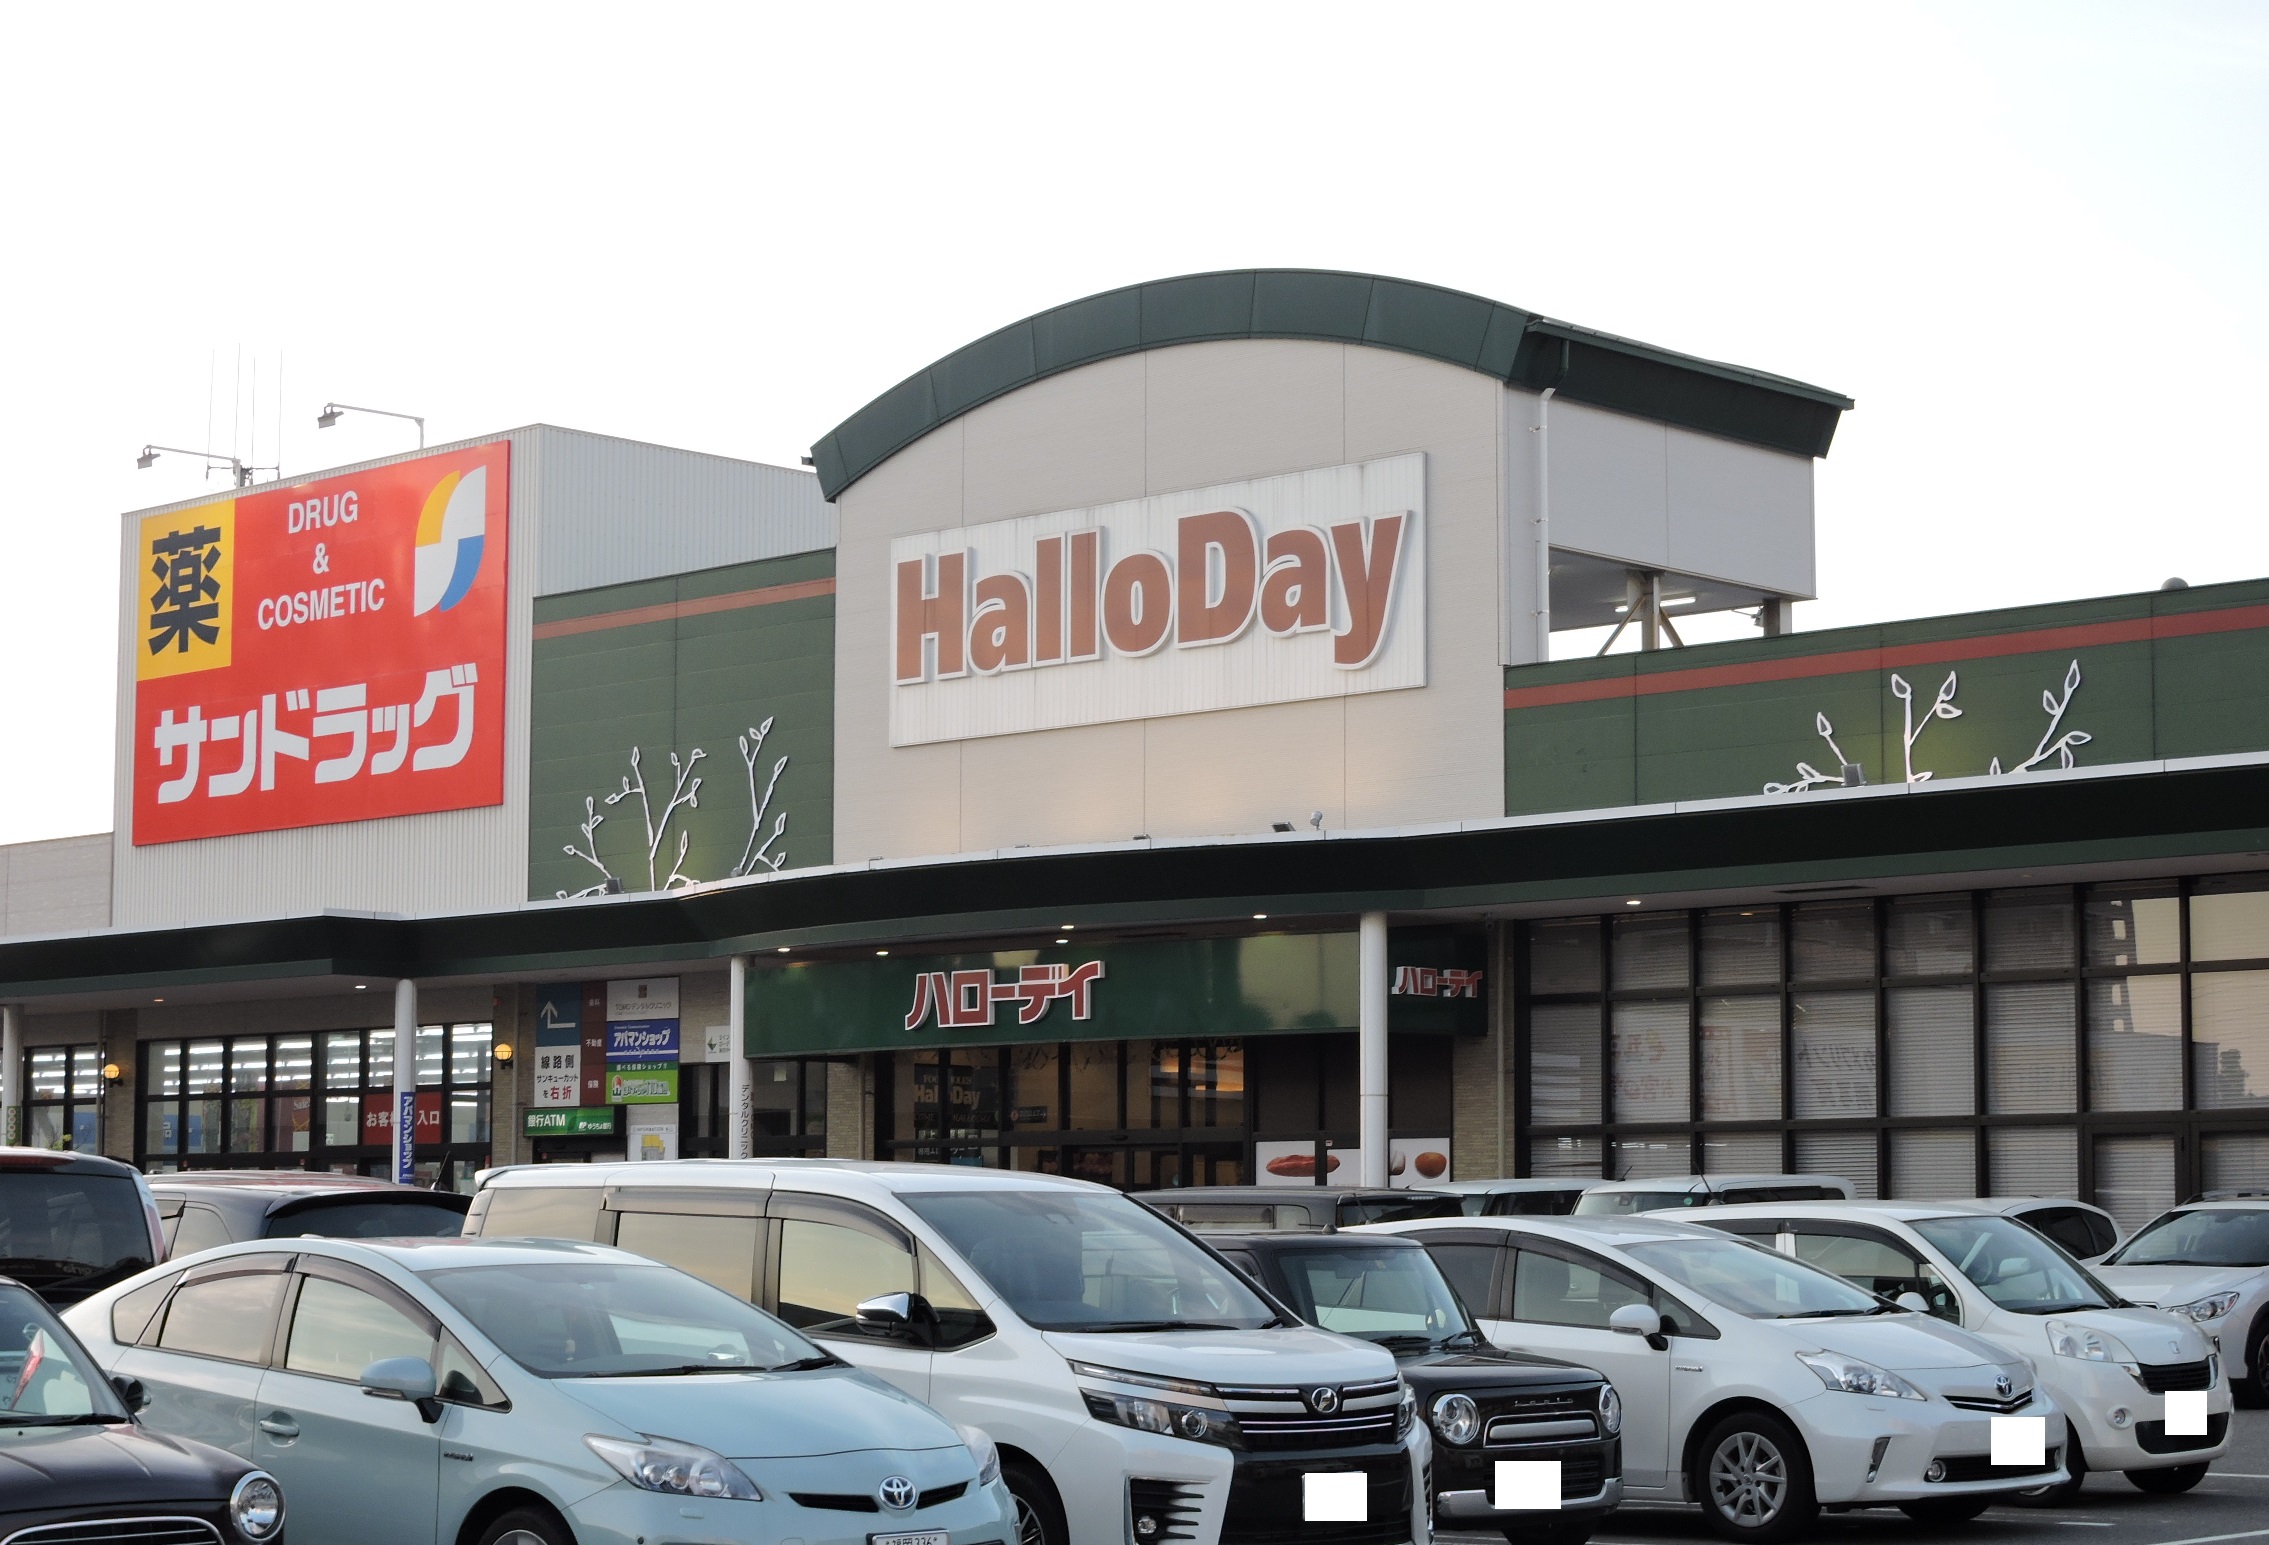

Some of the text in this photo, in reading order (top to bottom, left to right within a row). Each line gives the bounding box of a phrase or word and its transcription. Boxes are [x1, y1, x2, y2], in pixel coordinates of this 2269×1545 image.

[288, 490, 359, 534] DRUG
[312, 543, 329, 574] &
[148, 524, 222, 656] 薬
[257, 578, 386, 630] COSMETIC
[893, 505, 1412, 686] HalloDay
[154, 662, 479, 804] サンドラッグ
[613, 1028, 671, 1047] アパマンショップ
